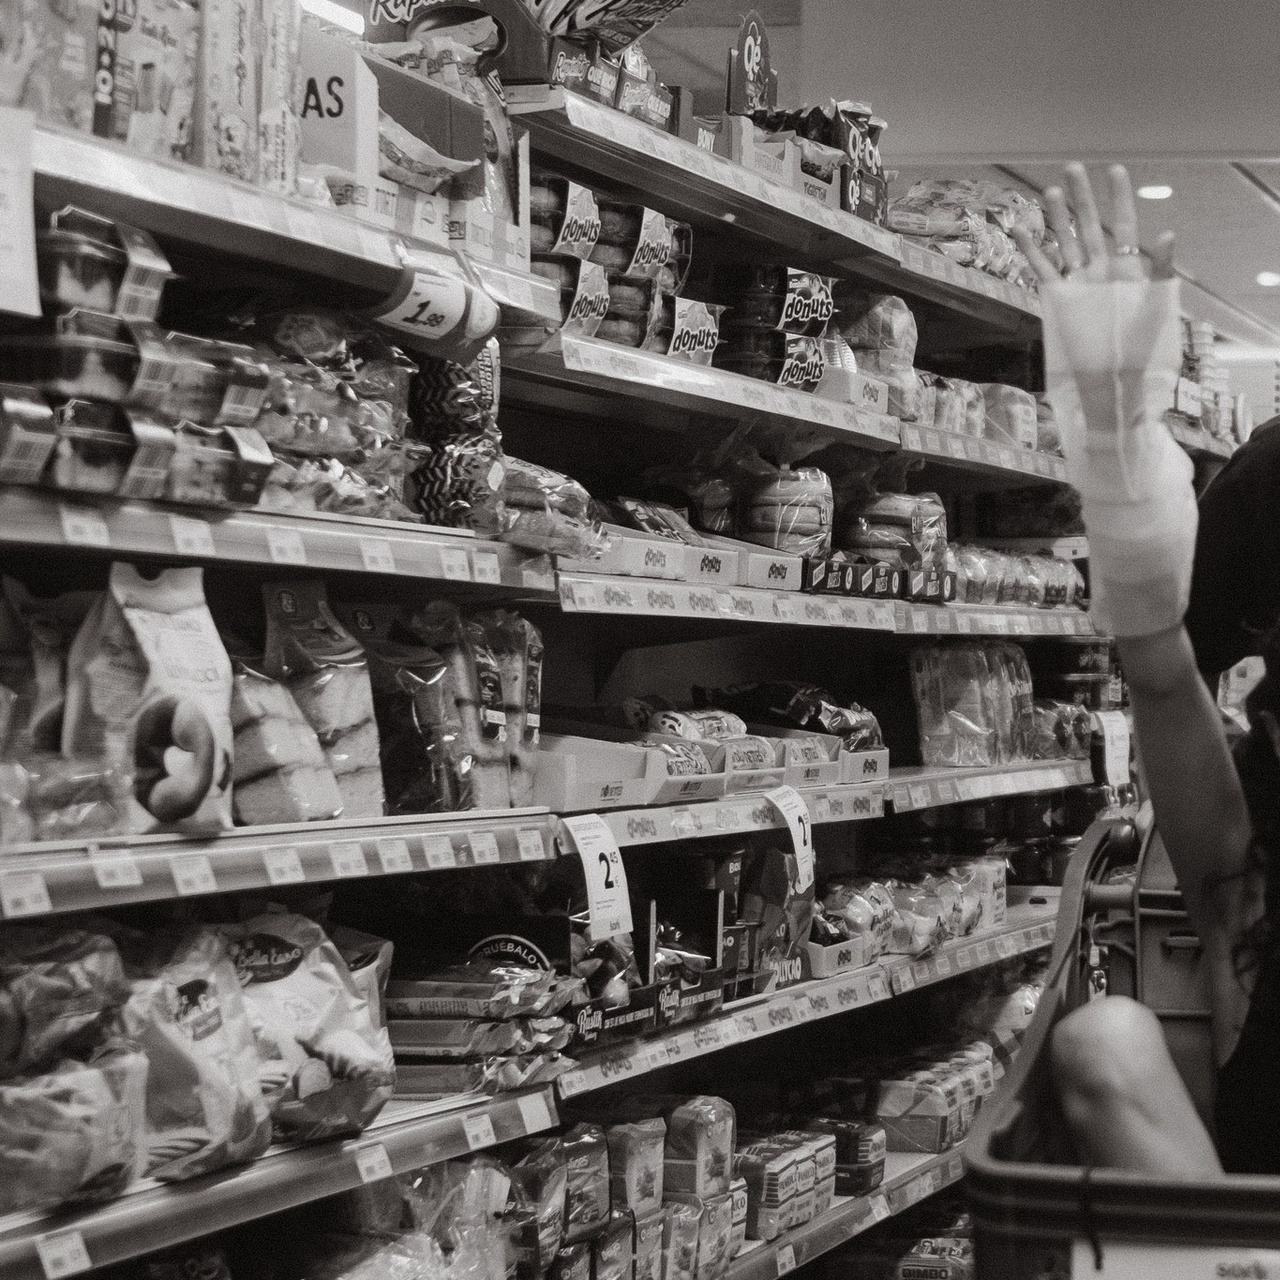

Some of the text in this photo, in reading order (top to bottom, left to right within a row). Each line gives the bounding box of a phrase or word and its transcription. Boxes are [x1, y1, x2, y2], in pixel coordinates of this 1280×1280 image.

[561, 216, 599, 243] donuts
[634, 240, 670, 265] donuts
[571, 292, 609, 319] donuts
[785, 296, 832, 320] donuts
[672, 328, 717, 353] donuts
[781, 361, 824, 385] donuts
